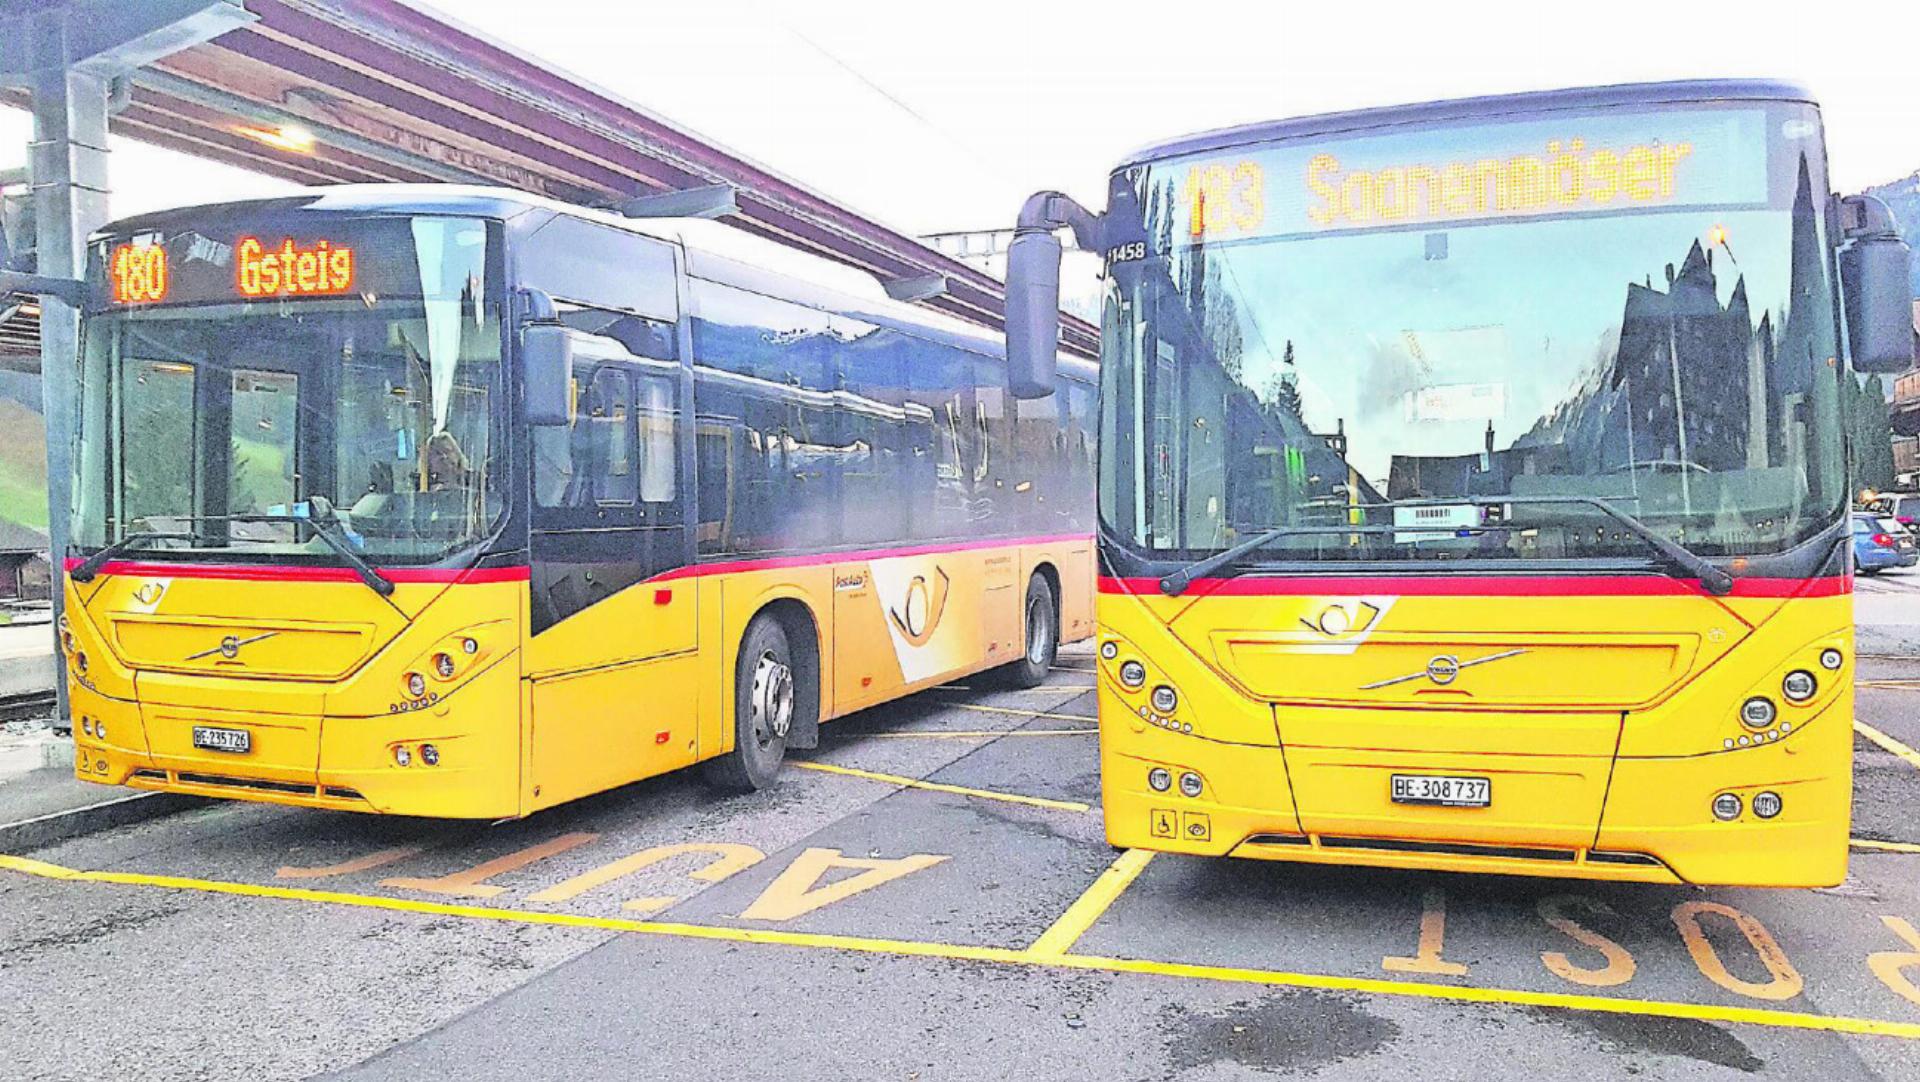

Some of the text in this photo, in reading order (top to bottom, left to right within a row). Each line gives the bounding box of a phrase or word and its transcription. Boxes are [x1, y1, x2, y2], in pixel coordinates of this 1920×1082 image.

[1184, 137, 1691, 235] 183 Saanenmöser
[114, 237, 353, 301] 180 Gsteig
